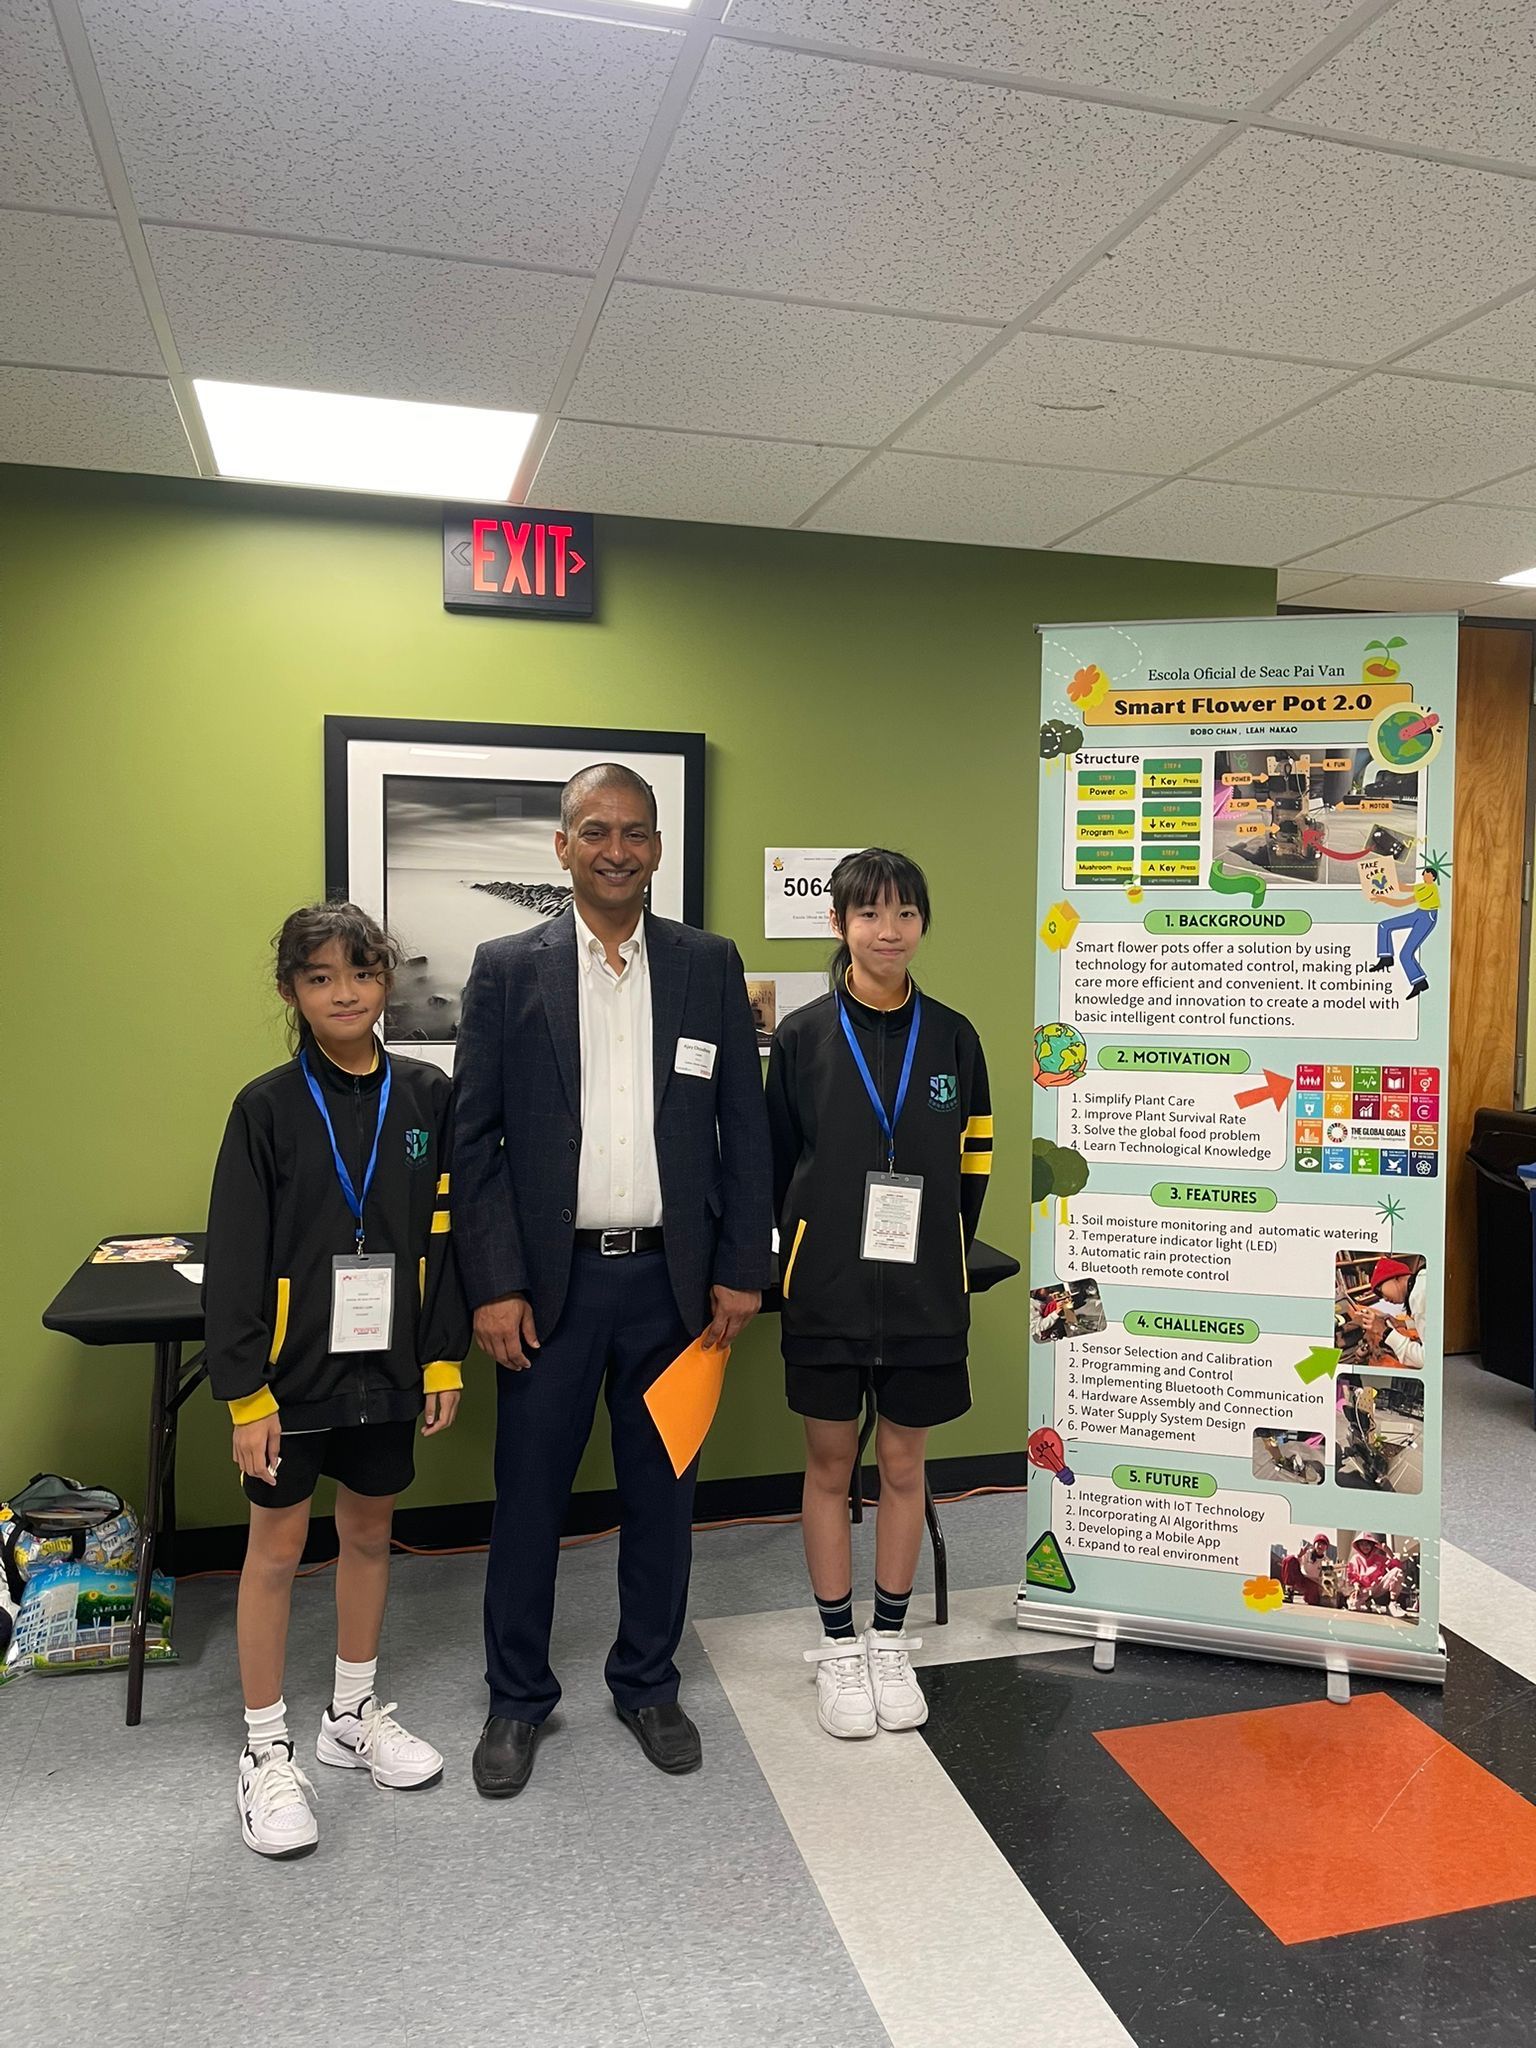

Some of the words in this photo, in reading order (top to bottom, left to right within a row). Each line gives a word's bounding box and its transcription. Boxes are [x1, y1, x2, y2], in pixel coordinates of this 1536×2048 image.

[473, 519, 572, 597] EXIT
[1148, 667, 1190, 681] Escola
[1193, 666, 1236, 680] Oficial
[1240, 666, 1256, 678] de
[1259, 666, 1290, 678] Seac
[1294, 664, 1314, 677] Pai
[1318, 665, 1344, 677] Van
[1114, 699, 1186, 715] Smart
[1192, 697, 1277, 713] Flower
[1283, 695, 1327, 711] Pot
[1333, 694, 1372, 710] 2.0
[1216, 727, 1241, 735] CHAN,
[1245, 726, 1265, 734] LEAH
[1075, 752, 1139, 764] Structure
[1161, 777, 1178, 785] Key
[1090, 788, 1116, 796] Power
[1160, 820, 1176, 828] Key
[1081, 829, 1114, 837] Program
[1160, 864, 1176, 872] Key
[1360, 861, 1378, 869] TAKE
[1366, 868, 1384, 879] CARE
[783, 877, 832, 897] 5064
[1371, 885, 1394, 895] EARTH
[1165, 914, 1174, 927] 1.
[1179, 914, 1285, 927] BACKGROUND
[1076, 941, 1114, 953] Smart
[1117, 940, 1158, 953] flower
[1161, 942, 1190, 956] pots
[1192, 941, 1223, 953] offer
[1226, 944, 1234, 954] a
[1238, 941, 1291, 954] solution
[1295, 942, 1312, 957] by
[1315, 942, 1351, 958] using
[1075, 958, 1146, 973] technology
[1149, 958, 1168, 971] for
[1171, 959, 1243, 971] automated
[1246, 959, 1298, 974] control,
[1302, 960, 1352, 976] making
[1356, 961, 1391, 975] plt
[1074, 978, 1102, 987] care
[1105, 978, 1139, 988] more
[1141, 975, 1194, 989] efficient
[1197, 977, 1222, 989] and
[1225, 977, 1303, 990] convenient.
[1307, 979, 1316, 990] It
[1319, 978, 1393, 995] combining
[1074, 992, 1144, 1008] knowledge
[1147, 994, 1172, 1006] and
[1175, 994, 1245, 1007] innovation
[1249, 996, 1263, 1007] to
[1266, 997, 1308, 1008] create
[1311, 999, 1319, 1008] a
[1323, 996, 1365, 1009] model
[1369, 997, 1399, 1009] with
[1074, 1010, 1107, 1022] basic
[1110, 1010, 1175, 1026] intelligent
[1178, 1012, 1225, 1024] control
[1229, 1012, 1294, 1026] functions.
[1117, 1050, 1128, 1063] 2.
[1133, 1050, 1230, 1065] MOTIVATION
[1072, 1092, 1081, 1103] 1.
[1084, 1092, 1131, 1107] Simplify
[1134, 1094, 1165, 1106] Plant
[1168, 1095, 1195, 1107] Care
[1071, 1108, 1081, 1118] 2.
[1084, 1109, 1132, 1122] Improve
[1135, 1110, 1166, 1122] Plant
[1168, 1111, 1215, 1123] Survival
[1219, 1113, 1246, 1125] Rate
[1071, 1124, 1080, 1134] 3.
[1084, 1124, 1115, 1136] Solve
[1118, 1125, 1137, 1136] the
[1139, 1126, 1176, 1139] global
[1179, 1126, 1206, 1139] food
[1209, 1129, 1260, 1142] problem
[1351, 1127, 1362, 1135] THE
[1363, 1128, 1385, 1136] GLOBAL
[1386, 1128, 1406, 1137] GOALS
[1071, 1140, 1080, 1150] 4.
[1083, 1140, 1116, 1151] Learn
[1119, 1141, 1201, 1157] Technological
[1204, 1145, 1271, 1161] Knowledge
[1170, 1187, 1181, 1200] 3.
[1186, 1188, 1257, 1204] FEATURES
[1069, 1214, 1078, 1224] 1.
[1081, 1214, 1103, 1226] Soil
[1106, 1216, 1158, 1228] moisture
[1161, 1220, 1227, 1235] monitoring
[1229, 1223, 1252, 1234] and
[1258, 1226, 1320, 1238] automatic
[1323, 1228, 1378, 1243] watering
[1068, 1245, 1078, 1256] 3.
[1080, 1246, 1140, 1259] Automatic
[1143, 1249, 1166, 1260] rain
[1169, 1253, 1231, 1265] protection
[1068, 1261, 1077, 1271] 4.
[1081, 1261, 1138, 1275] Bluetooth
[1141, 1267, 1183, 1278] remote
[1186, 1270, 1229, 1281] control
[1137, 1315, 1149, 1328] 4.
[1154, 1316, 1245, 1335] CHALLENGES
[1070, 1341, 1079, 1352] 1.
[1082, 1342, 1121, 1355] Sensor
[1124, 1345, 1178, 1360] Selection
[1181, 1351, 1203, 1362] and
[1206, 1352, 1272, 1367] Calibration
[1068, 1372, 1078, 1383] 3.
[1081, 1374, 1163, 1394] Implementing
[1165, 1380, 1223, 1396] Bluetooth
[1226, 1386, 1324, 1404] Communication
[1067, 1419, 1077, 1430] 6.
[1080, 1421, 1117, 1434] Power
[1119, 1424, 1195, 1442] Management
[1129, 1470, 1140, 1483] 5.
[1145, 1471, 1199, 1489] FUTURE
[1067, 1489, 1076, 1500] 1.
[1079, 1490, 1142, 1506] Integration
[1145, 1497, 1170, 1509] with
[1174, 1500, 1192, 1512] IoT
[1195, 1502, 1265, 1522] Technology
[1065, 1520, 1075, 1531] 3.
[1078, 1521, 1143, 1541] Developing
[1145, 1531, 1152, 1539] a
[1155, 1530, 1194, 1544] Mobile
[1196, 1535, 1221, 1549] App
[1064, 1536, 1075, 1547] 4.
[1078, 1537, 1120, 1551] Expand
[1123, 1543, 1135, 1553] to
[1138, 1545, 1160, 1557] real
[1162, 1549, 1239, 1566] environment
